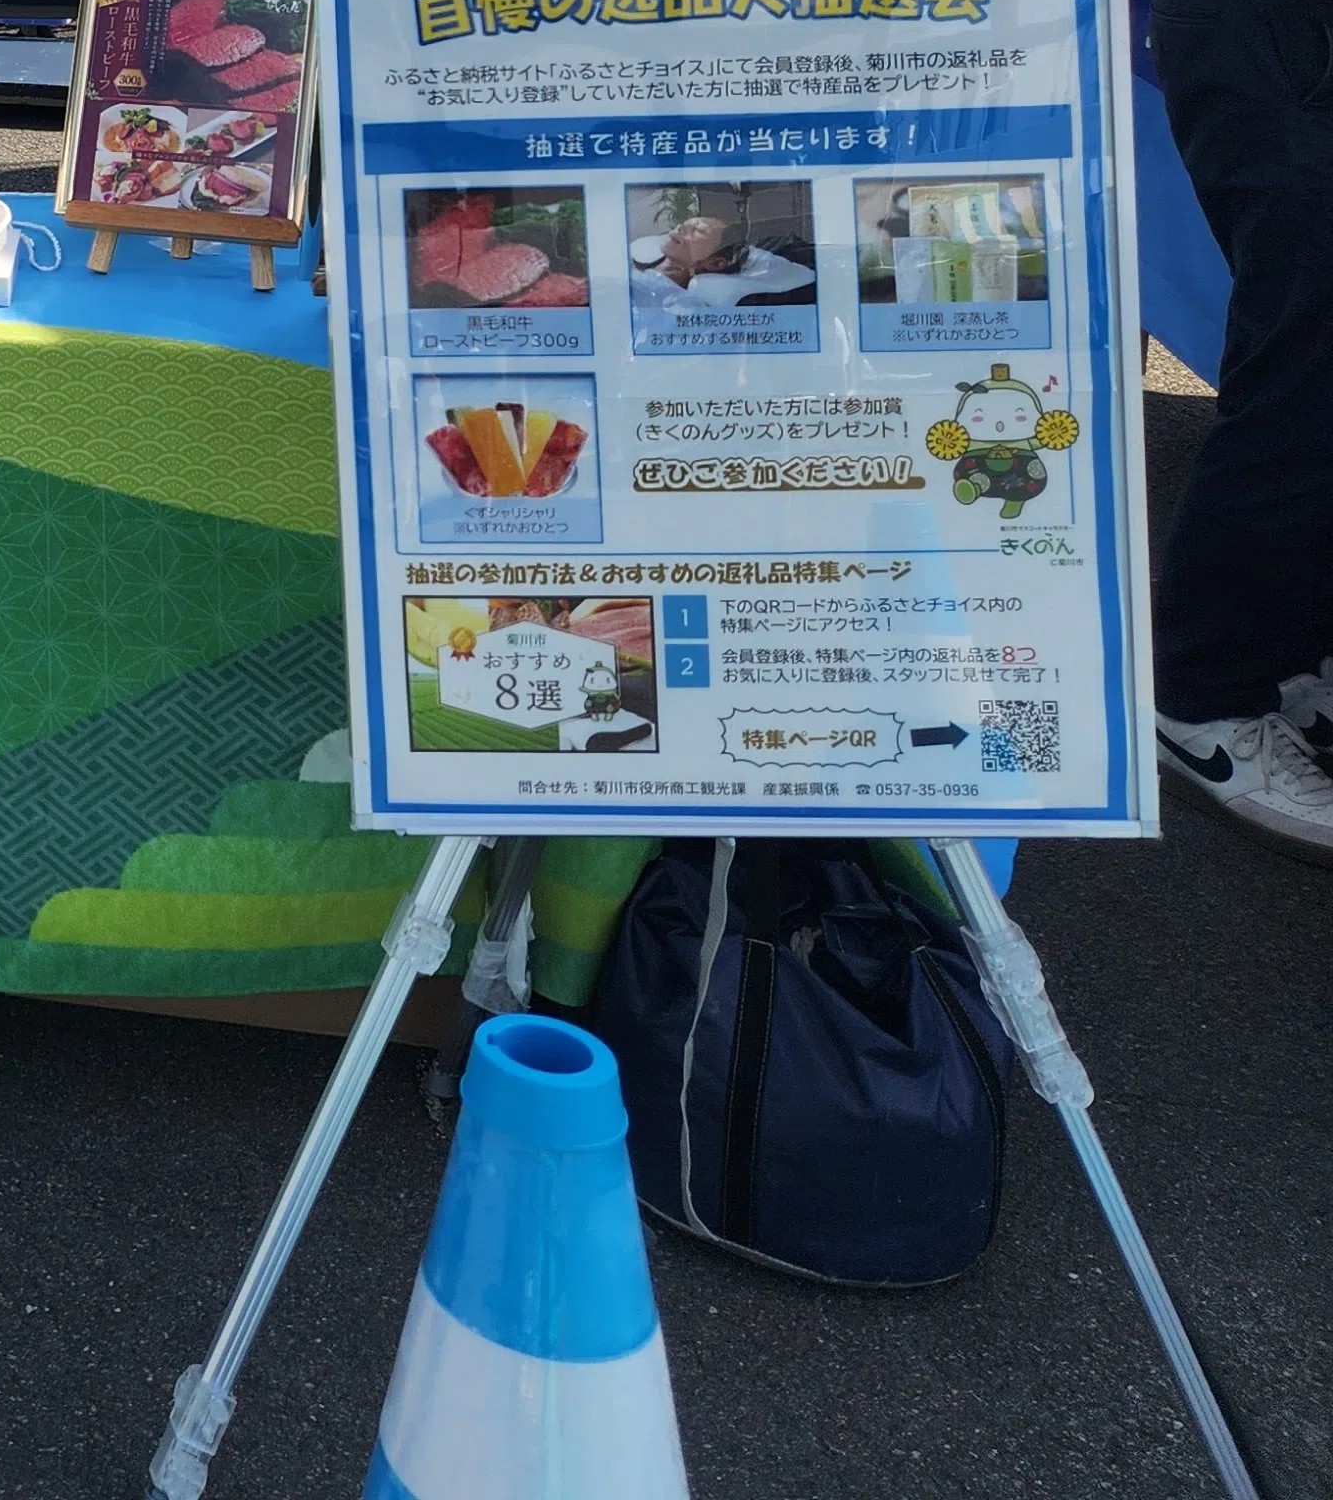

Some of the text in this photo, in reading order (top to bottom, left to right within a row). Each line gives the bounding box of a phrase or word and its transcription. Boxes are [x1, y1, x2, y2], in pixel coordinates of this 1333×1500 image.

[120, 5, 141, 67] 黒毛和牛
[99, 6, 119, 91] ローストビーフ
[525, 122, 917, 160] 抽選で特産品が当たります！
[466, 315, 533, 332] 黒毛和牛
[675, 313, 775, 328] 整体院の先生が
[900, 311, 1010, 326] 堀川園 深蒸し茶
[424, 332, 580, 351] ローストビーフ300g
[645, 396, 904, 419] 参加いただいた方には参加賞
[633, 454, 915, 491] ぜひご参加ください！
[463, 504, 558, 520] くずシャリシャリ
[1000, 537, 1075, 556] きくのん
[719, 595, 1023, 617] 下のQRコードからふるさとチョイス内の
[504, 632, 548, 648] 菊川市
[483, 651, 572, 672] おすすめ
[721, 643, 1038, 666] 会員登録後、特集ページ内の返礼品を8つ
[494, 677, 565, 714] 8選
[741, 727, 878, 752] 特集ページQR
[762, 780, 840, 798] 産業振興係
[875, 782, 980, 799] 0537-35-0936
